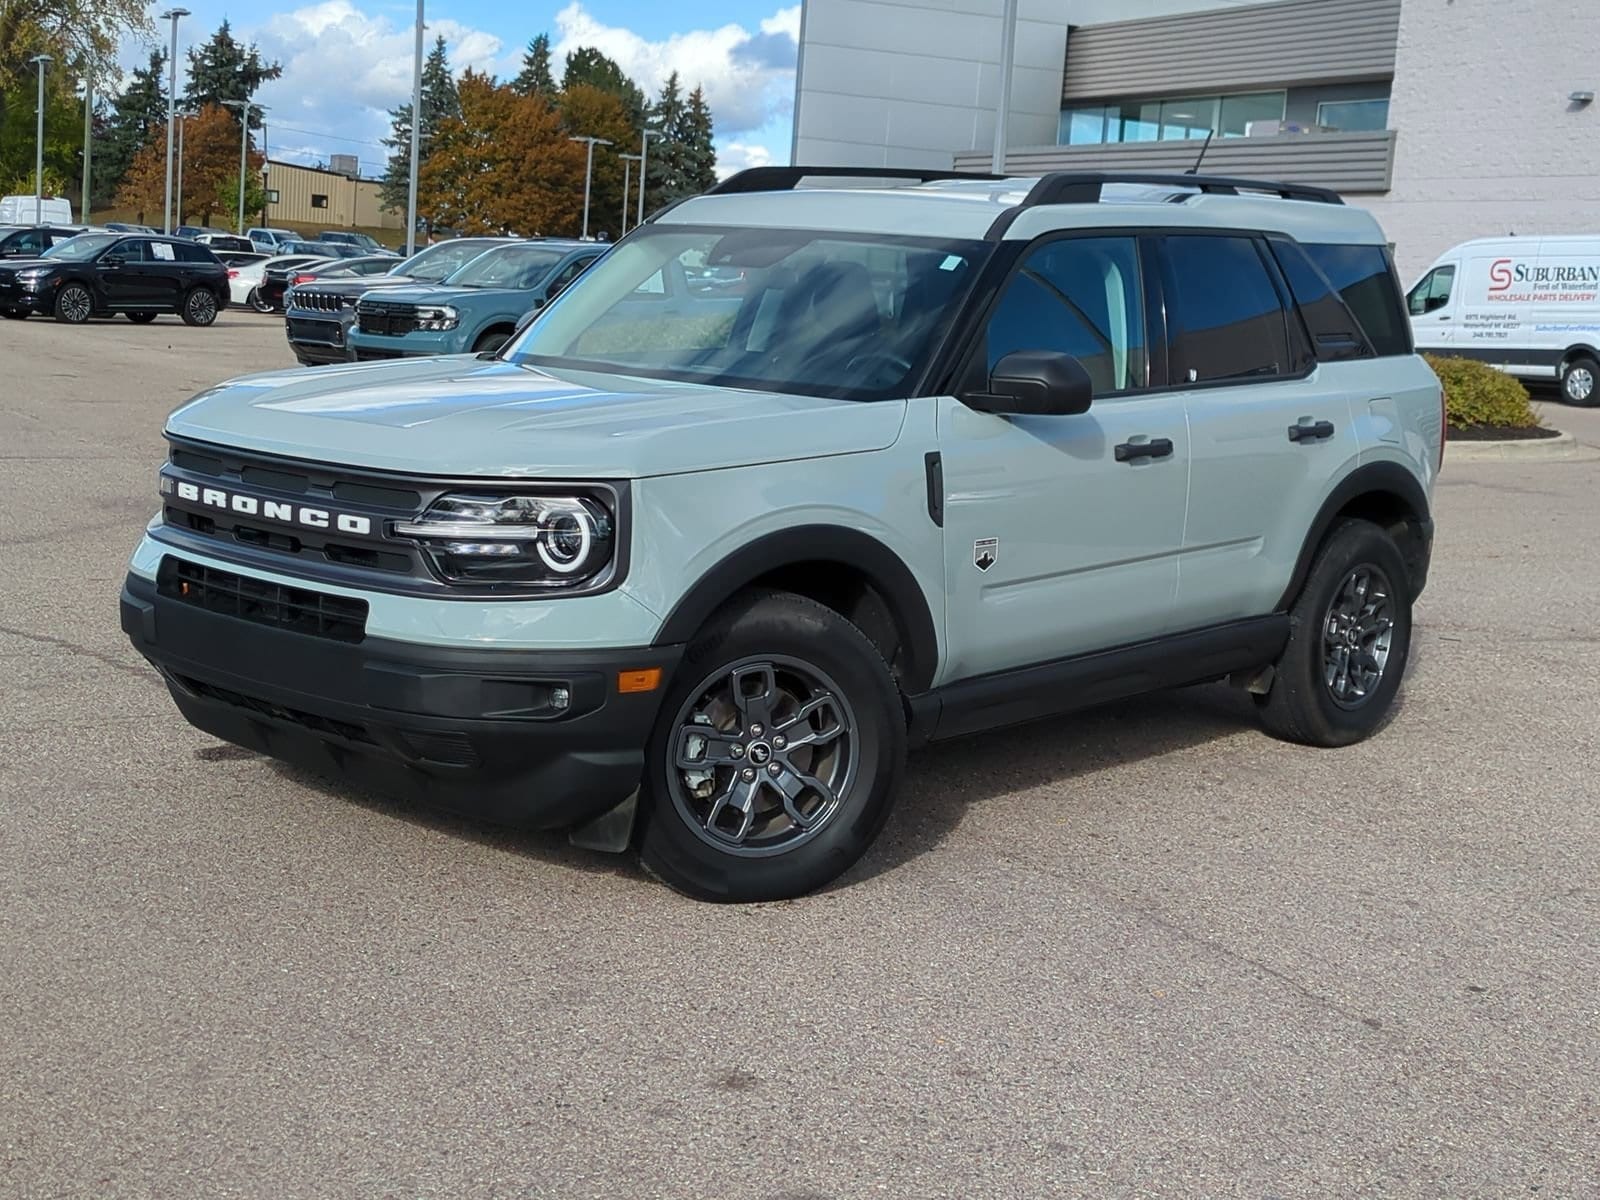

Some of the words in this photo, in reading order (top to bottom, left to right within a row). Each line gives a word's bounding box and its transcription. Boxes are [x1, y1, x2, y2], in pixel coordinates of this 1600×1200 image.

[1513, 264, 1600, 282] SUBURBAN
[1533, 283, 1550, 291] Ford
[1551, 283, 1560, 291] of
[1561, 283, 1598, 291] Waterford
[1558, 293, 1597, 301] DELIVERY
[177, 481, 371, 535] BRONCO
